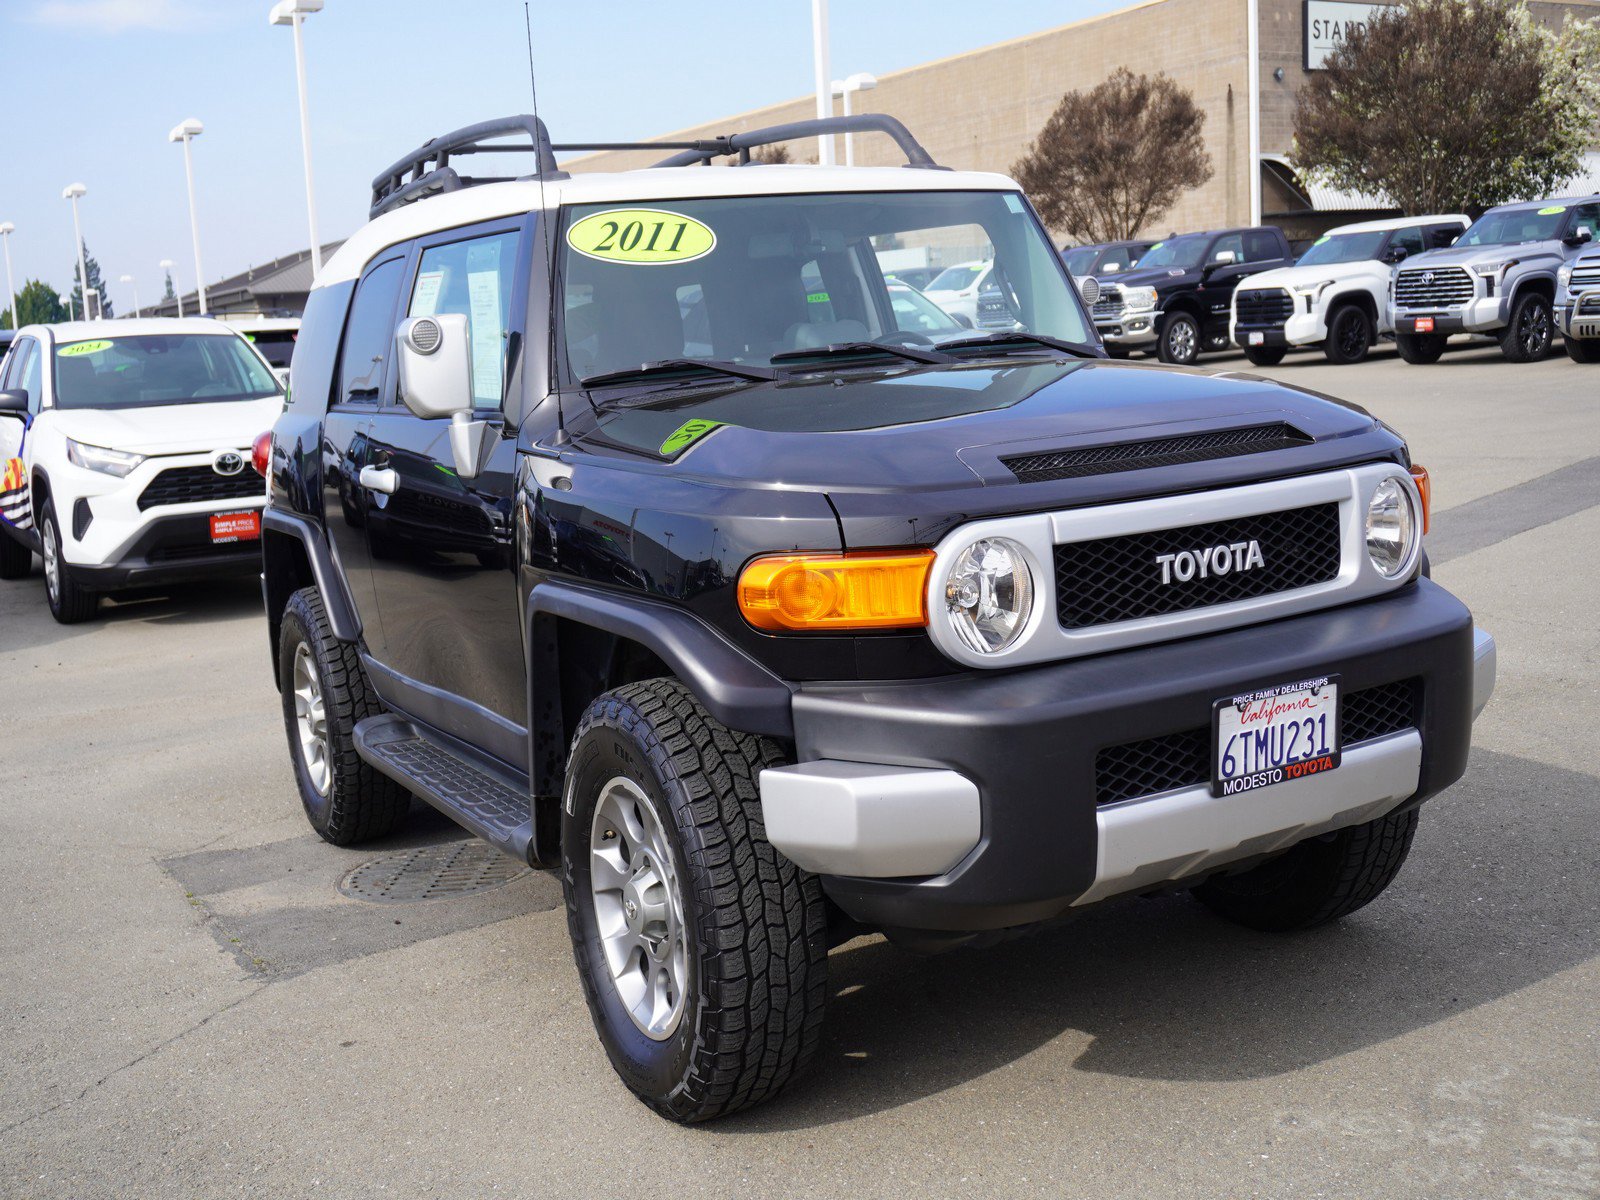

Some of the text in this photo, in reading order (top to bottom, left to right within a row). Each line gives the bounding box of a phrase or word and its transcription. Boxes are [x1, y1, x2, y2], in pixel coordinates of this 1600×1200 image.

[592, 220, 688, 253] 2011
[1155, 540, 1265, 585] TOYOTA
[1232, 677, 1329, 705] PRICE FAMILY DEALERSHIPS
[1240, 694, 1317, 724] California
[1221, 713, 1330, 778] 6TMU231
[1223, 756, 1333, 795] MODESTO TOYOTA
